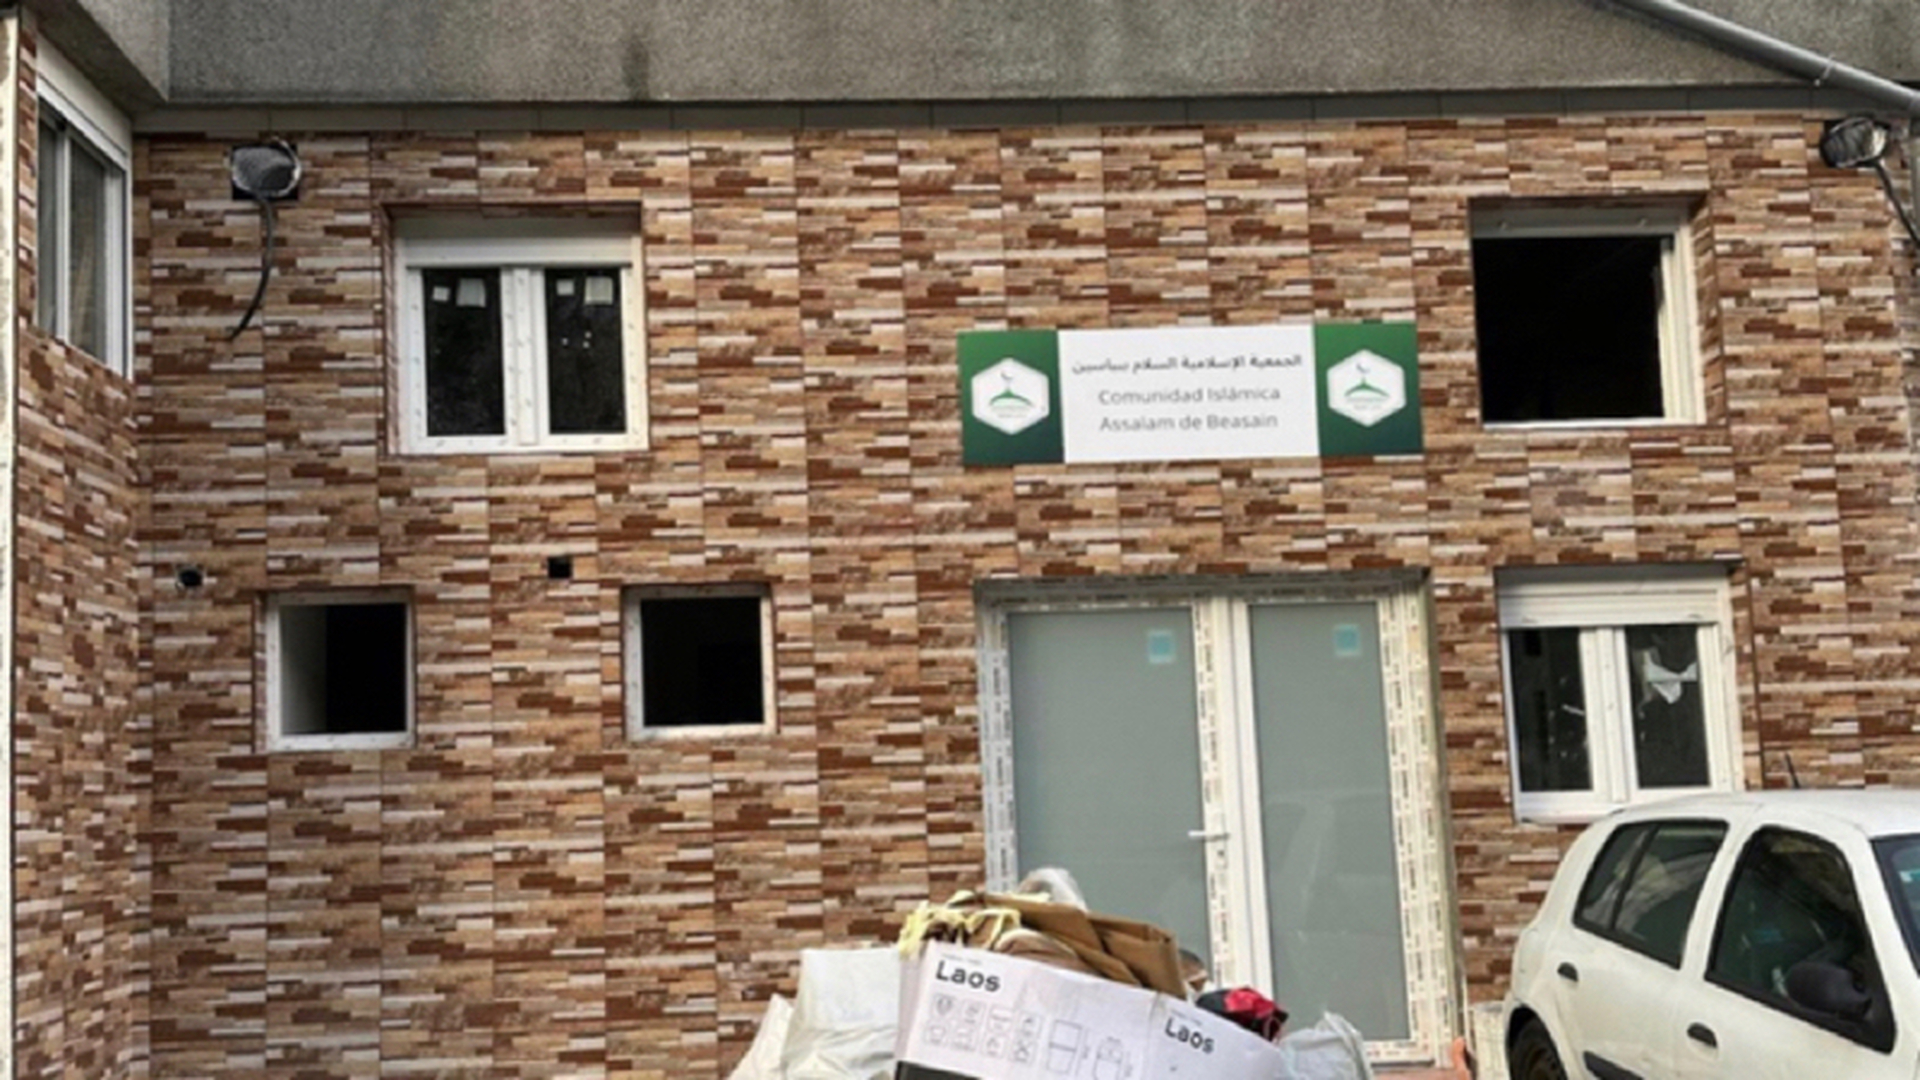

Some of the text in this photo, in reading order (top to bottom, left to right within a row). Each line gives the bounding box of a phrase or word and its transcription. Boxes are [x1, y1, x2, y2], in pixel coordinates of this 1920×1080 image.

[1098, 386, 1280, 405] Comunidad Islámica
[1100, 414, 1278, 431] Assalam de Beasain
[935, 960, 1001, 992] Laos
[1165, 1016, 1214, 1054] Laos
